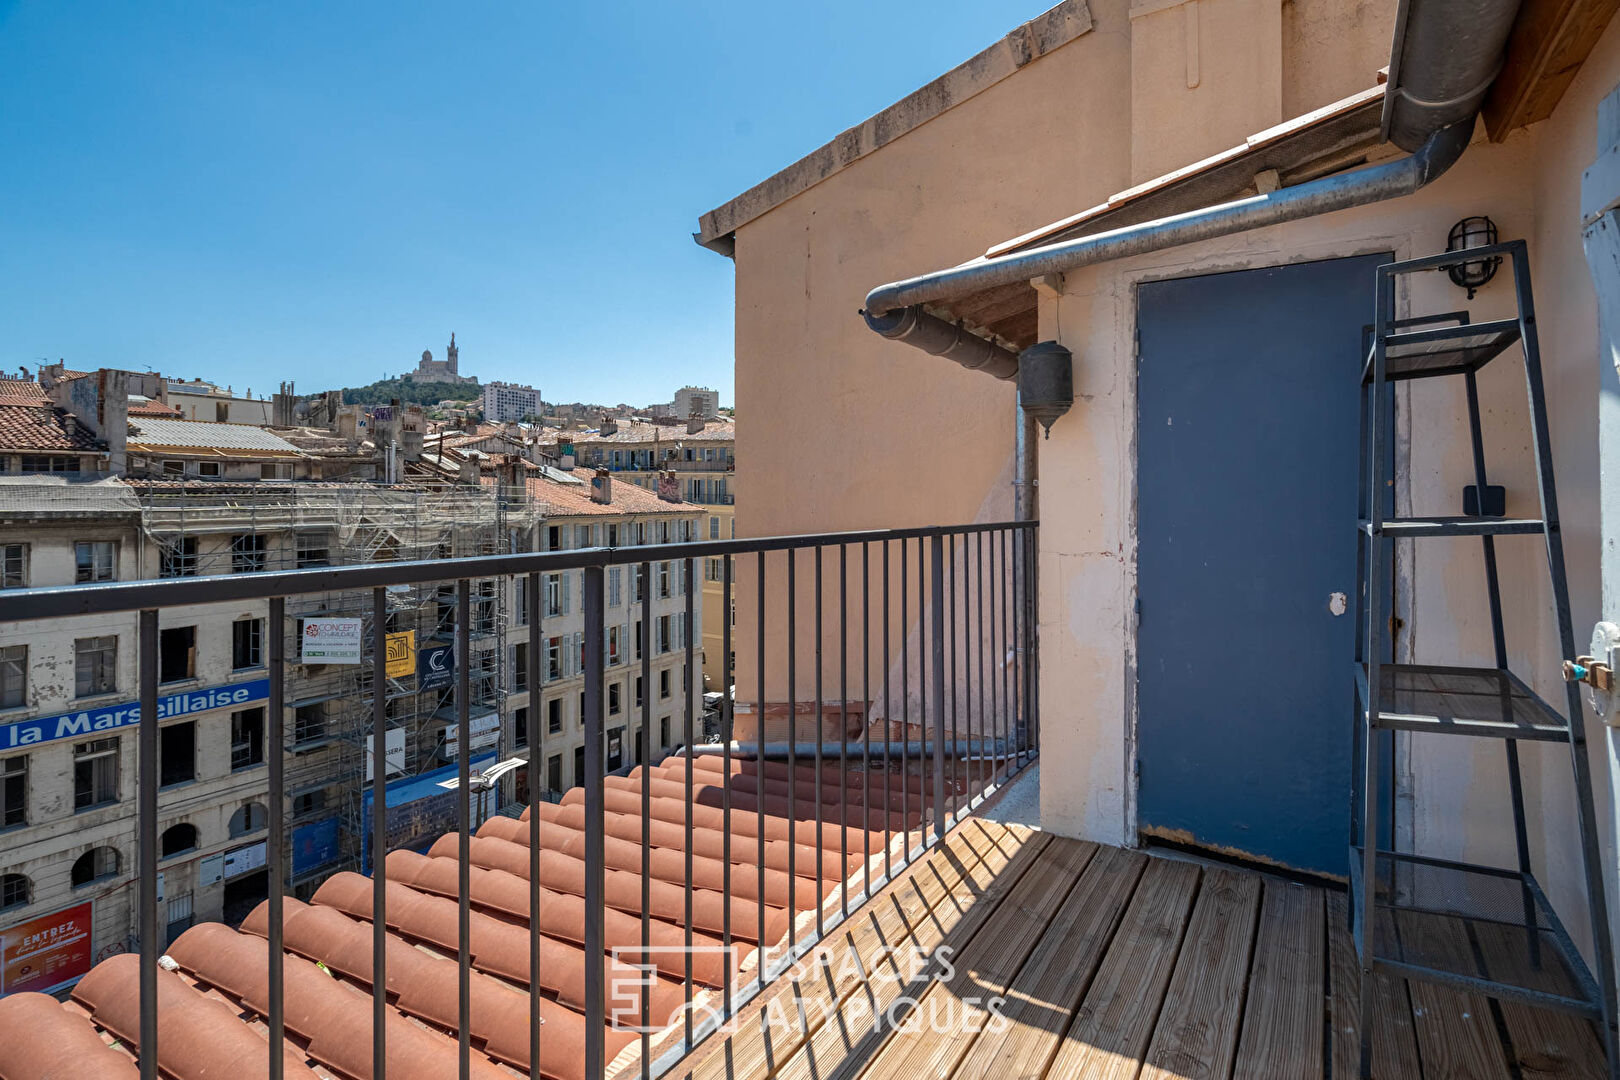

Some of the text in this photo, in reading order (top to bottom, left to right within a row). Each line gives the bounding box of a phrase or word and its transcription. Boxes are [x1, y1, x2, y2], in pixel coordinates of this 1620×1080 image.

[318, 623, 358, 632] CONCEPT
[9, 687, 250, 747] la Marseillaise
[23, 920, 74, 946] ENTREZ
